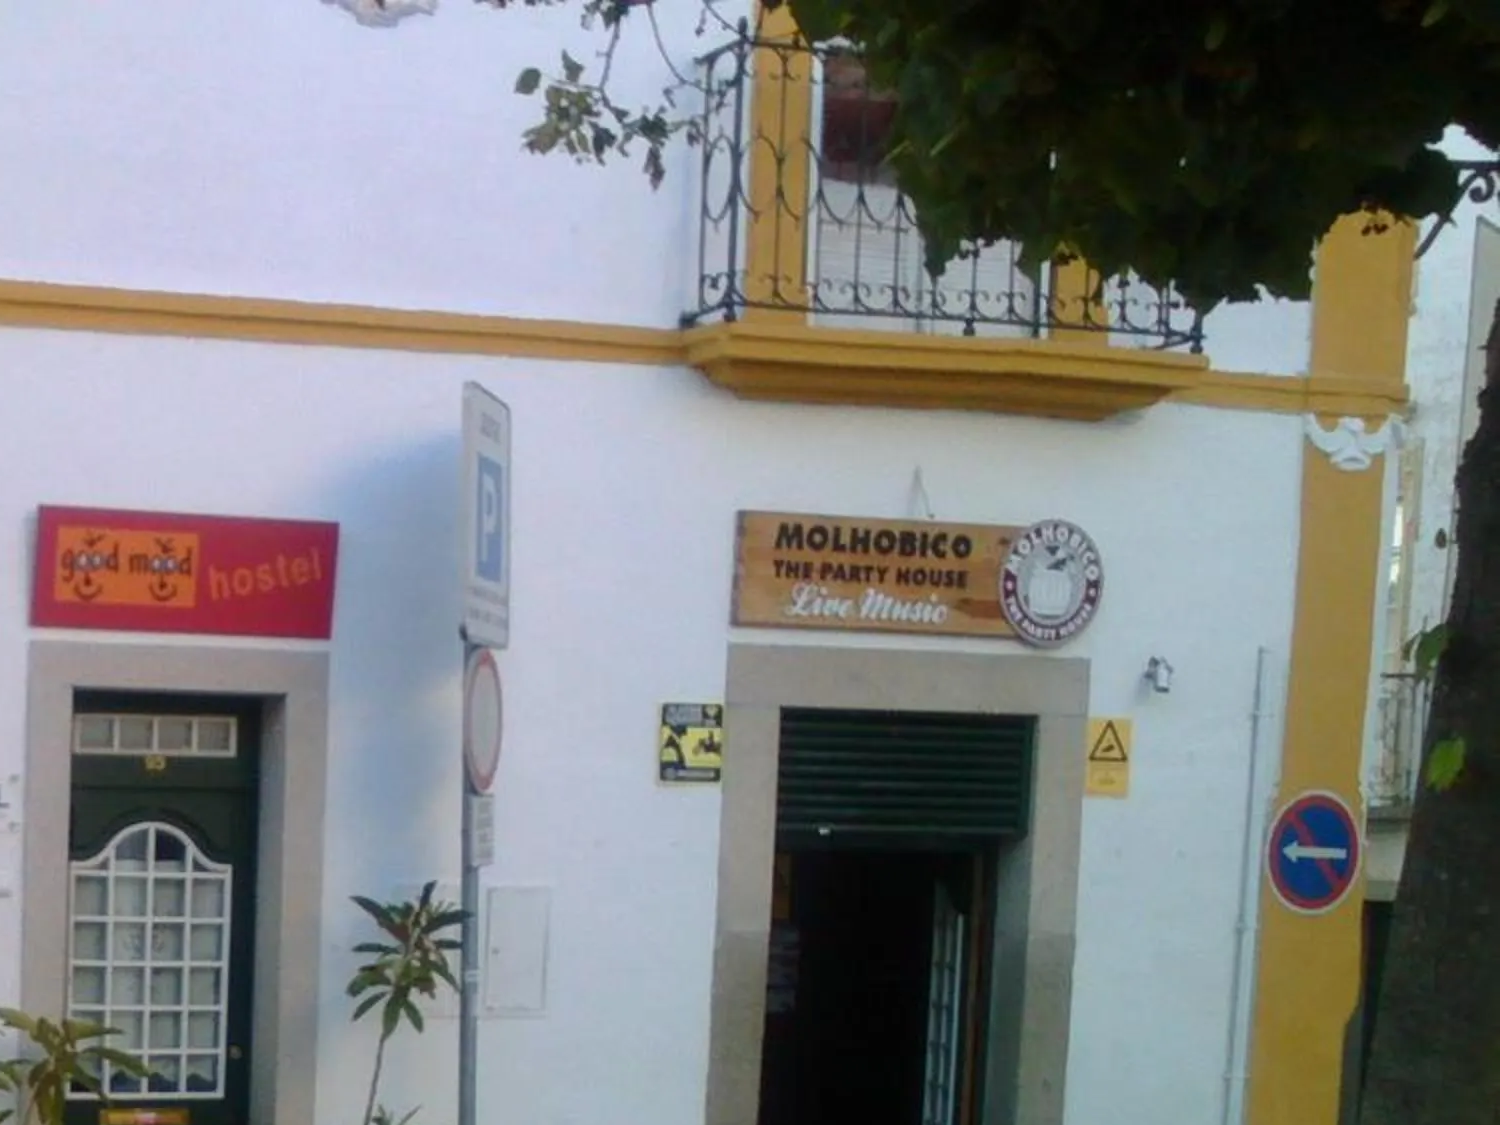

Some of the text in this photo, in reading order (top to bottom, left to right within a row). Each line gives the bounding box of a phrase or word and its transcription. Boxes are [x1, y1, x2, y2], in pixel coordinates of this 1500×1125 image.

[774, 522, 973, 559] MOLHOBICO
[1006, 525, 1100, 581] MOLHOBICO
[60, 544, 193, 583] good mood
[208, 549, 323, 601] hostel
[772, 559, 970, 589] THE PARTY HOUSE
[784, 580, 948, 625] Live Music
